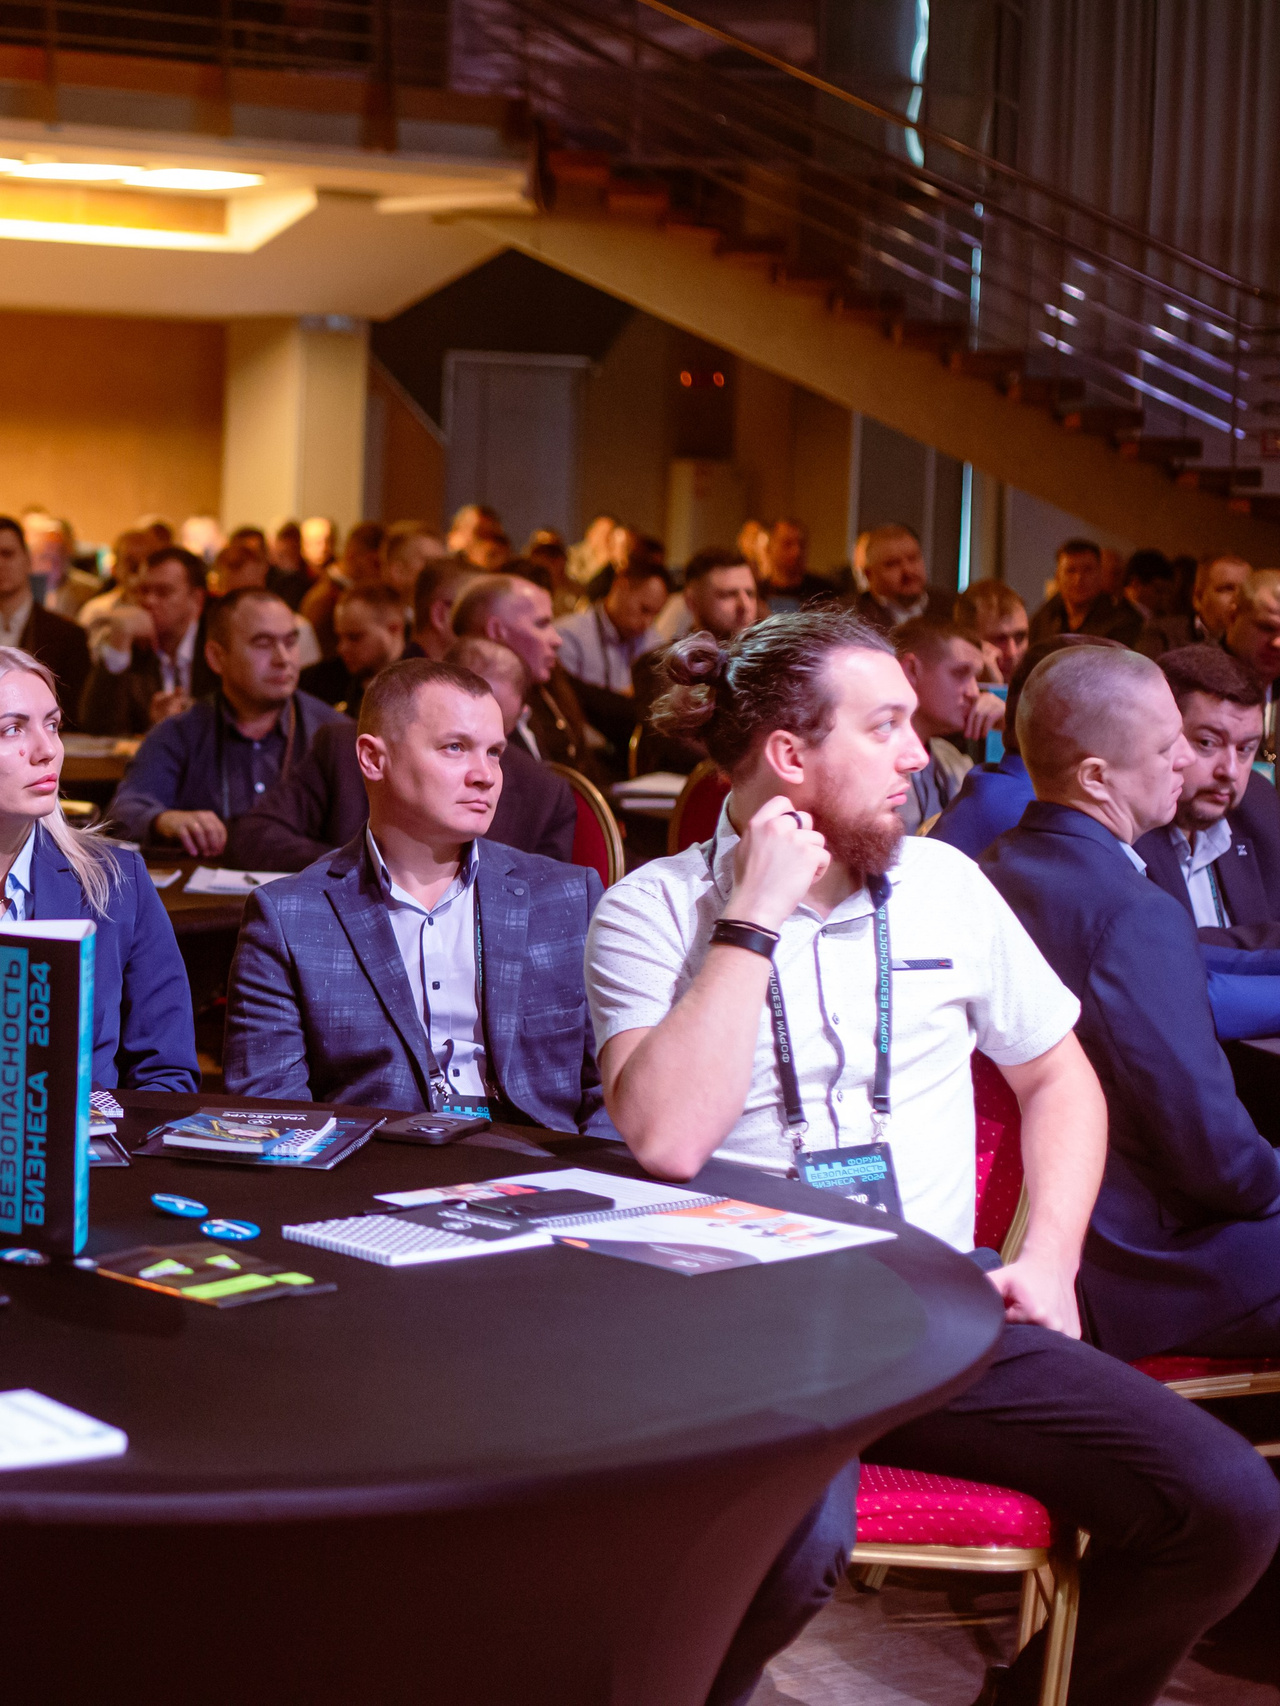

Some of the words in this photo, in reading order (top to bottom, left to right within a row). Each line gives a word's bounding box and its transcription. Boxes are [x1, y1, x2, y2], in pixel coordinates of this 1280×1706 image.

[878, 923, 889, 1009] БЕЗОПАСНОСТЬ
[28, 961, 51, 1047] 2024
[776, 1020, 790, 1063] ФОРУМ
[880, 1012, 889, 1054] ФОРУМ
[0, 960, 22, 1220] БЕЗОПАСНОСТЬ
[24, 1071, 49, 1226] БИЗНЕСА
[847, 1154, 883, 1166] ФОРУМ
[810, 1163, 884, 1180] БЕЗОПАСНОСТЬ
[812, 1178, 856, 1190] БИЗНЕСА
[861, 1172, 886, 1182] 2024
